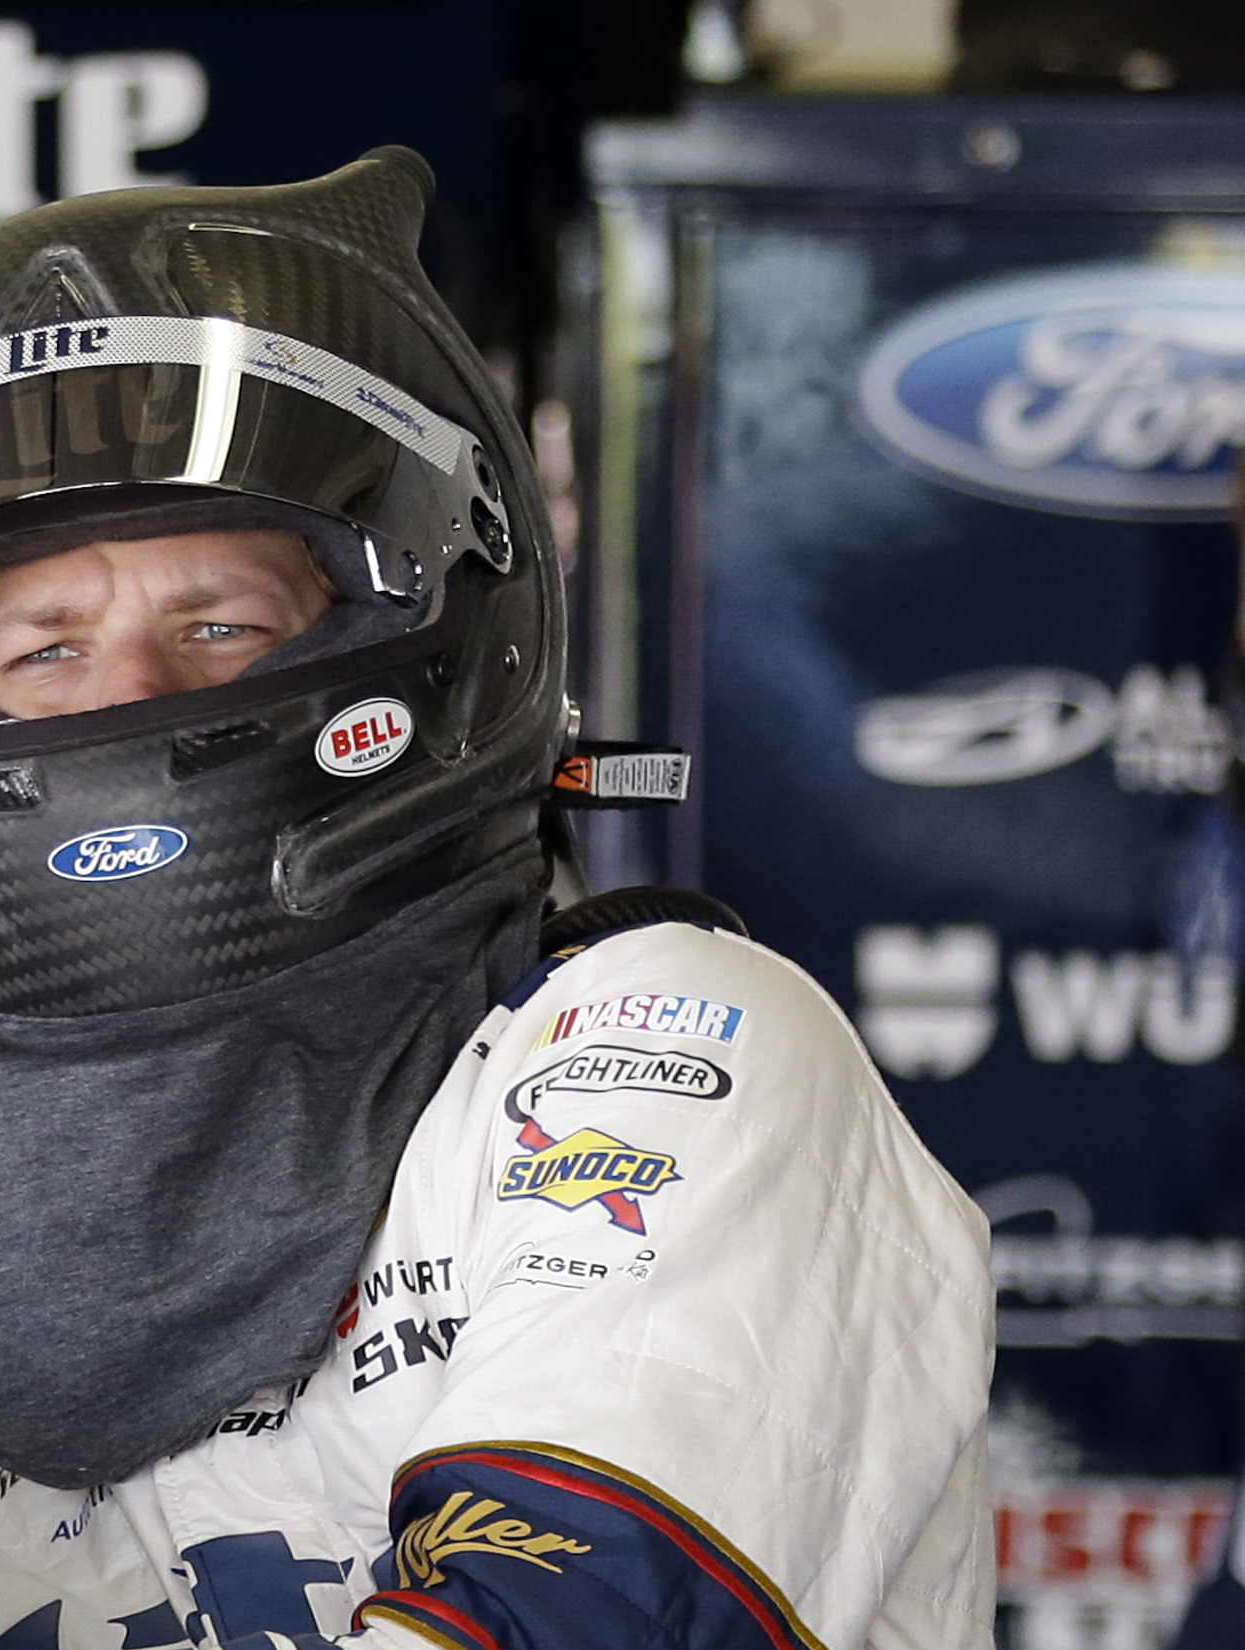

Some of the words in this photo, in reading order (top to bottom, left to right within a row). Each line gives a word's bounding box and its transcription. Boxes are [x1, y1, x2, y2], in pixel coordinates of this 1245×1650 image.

[4, 325, 110, 374] Lite
[978, 308, 1238, 470] For
[330, 711, 403, 759] BELL
[73, 833, 161, 876] Ford
[567, 995, 730, 1041] NASCAR
[502, 1152, 667, 1193] SUNOCO
